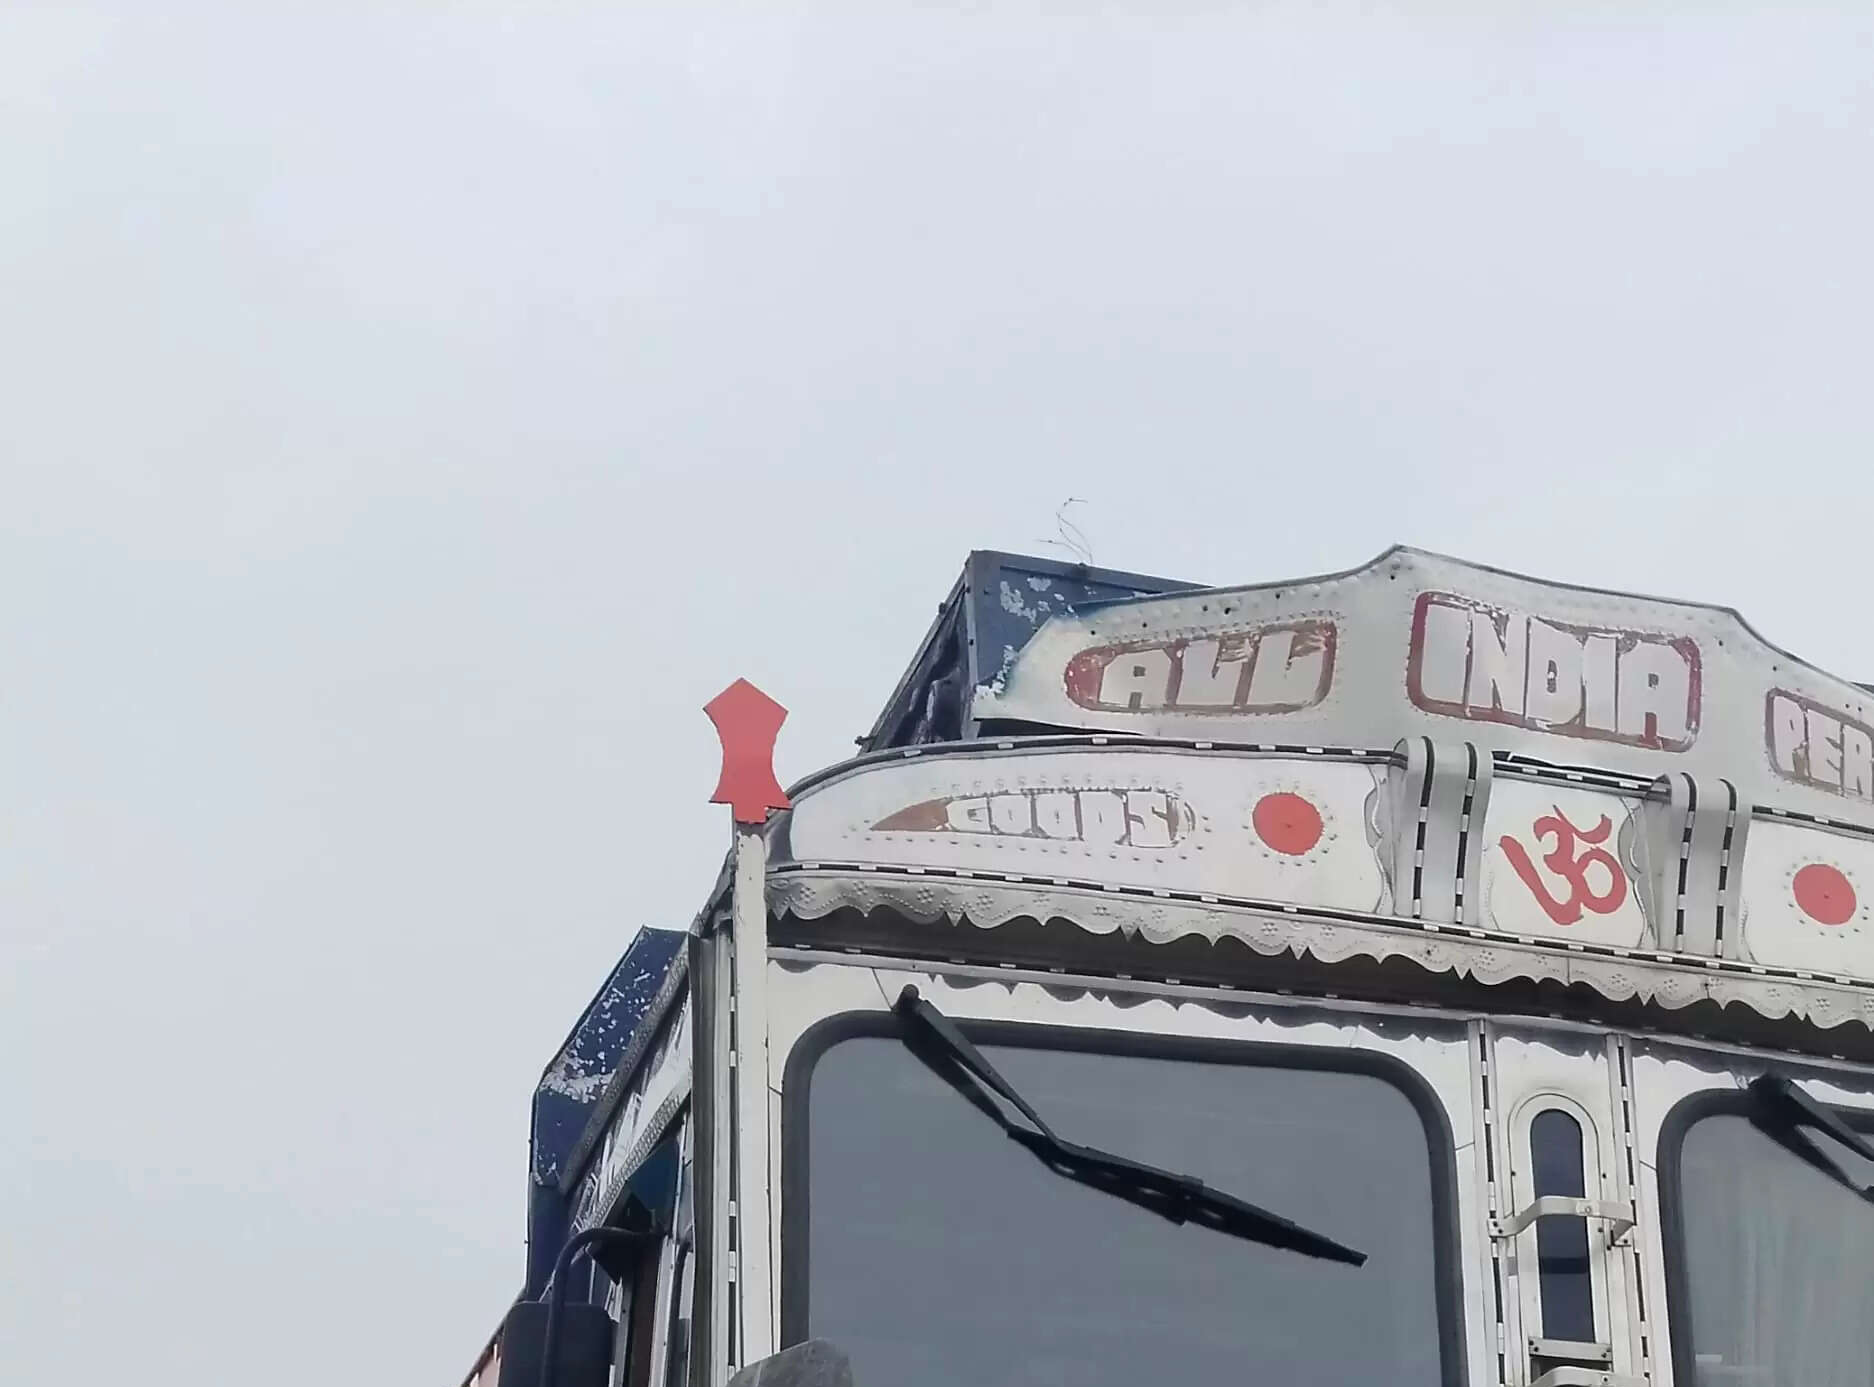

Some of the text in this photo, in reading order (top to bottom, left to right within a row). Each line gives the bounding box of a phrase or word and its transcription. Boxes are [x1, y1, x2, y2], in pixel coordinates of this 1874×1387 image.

[1098, 603, 1874, 803] ALL INDIA PER
[944, 790, 1172, 849] GOODS
